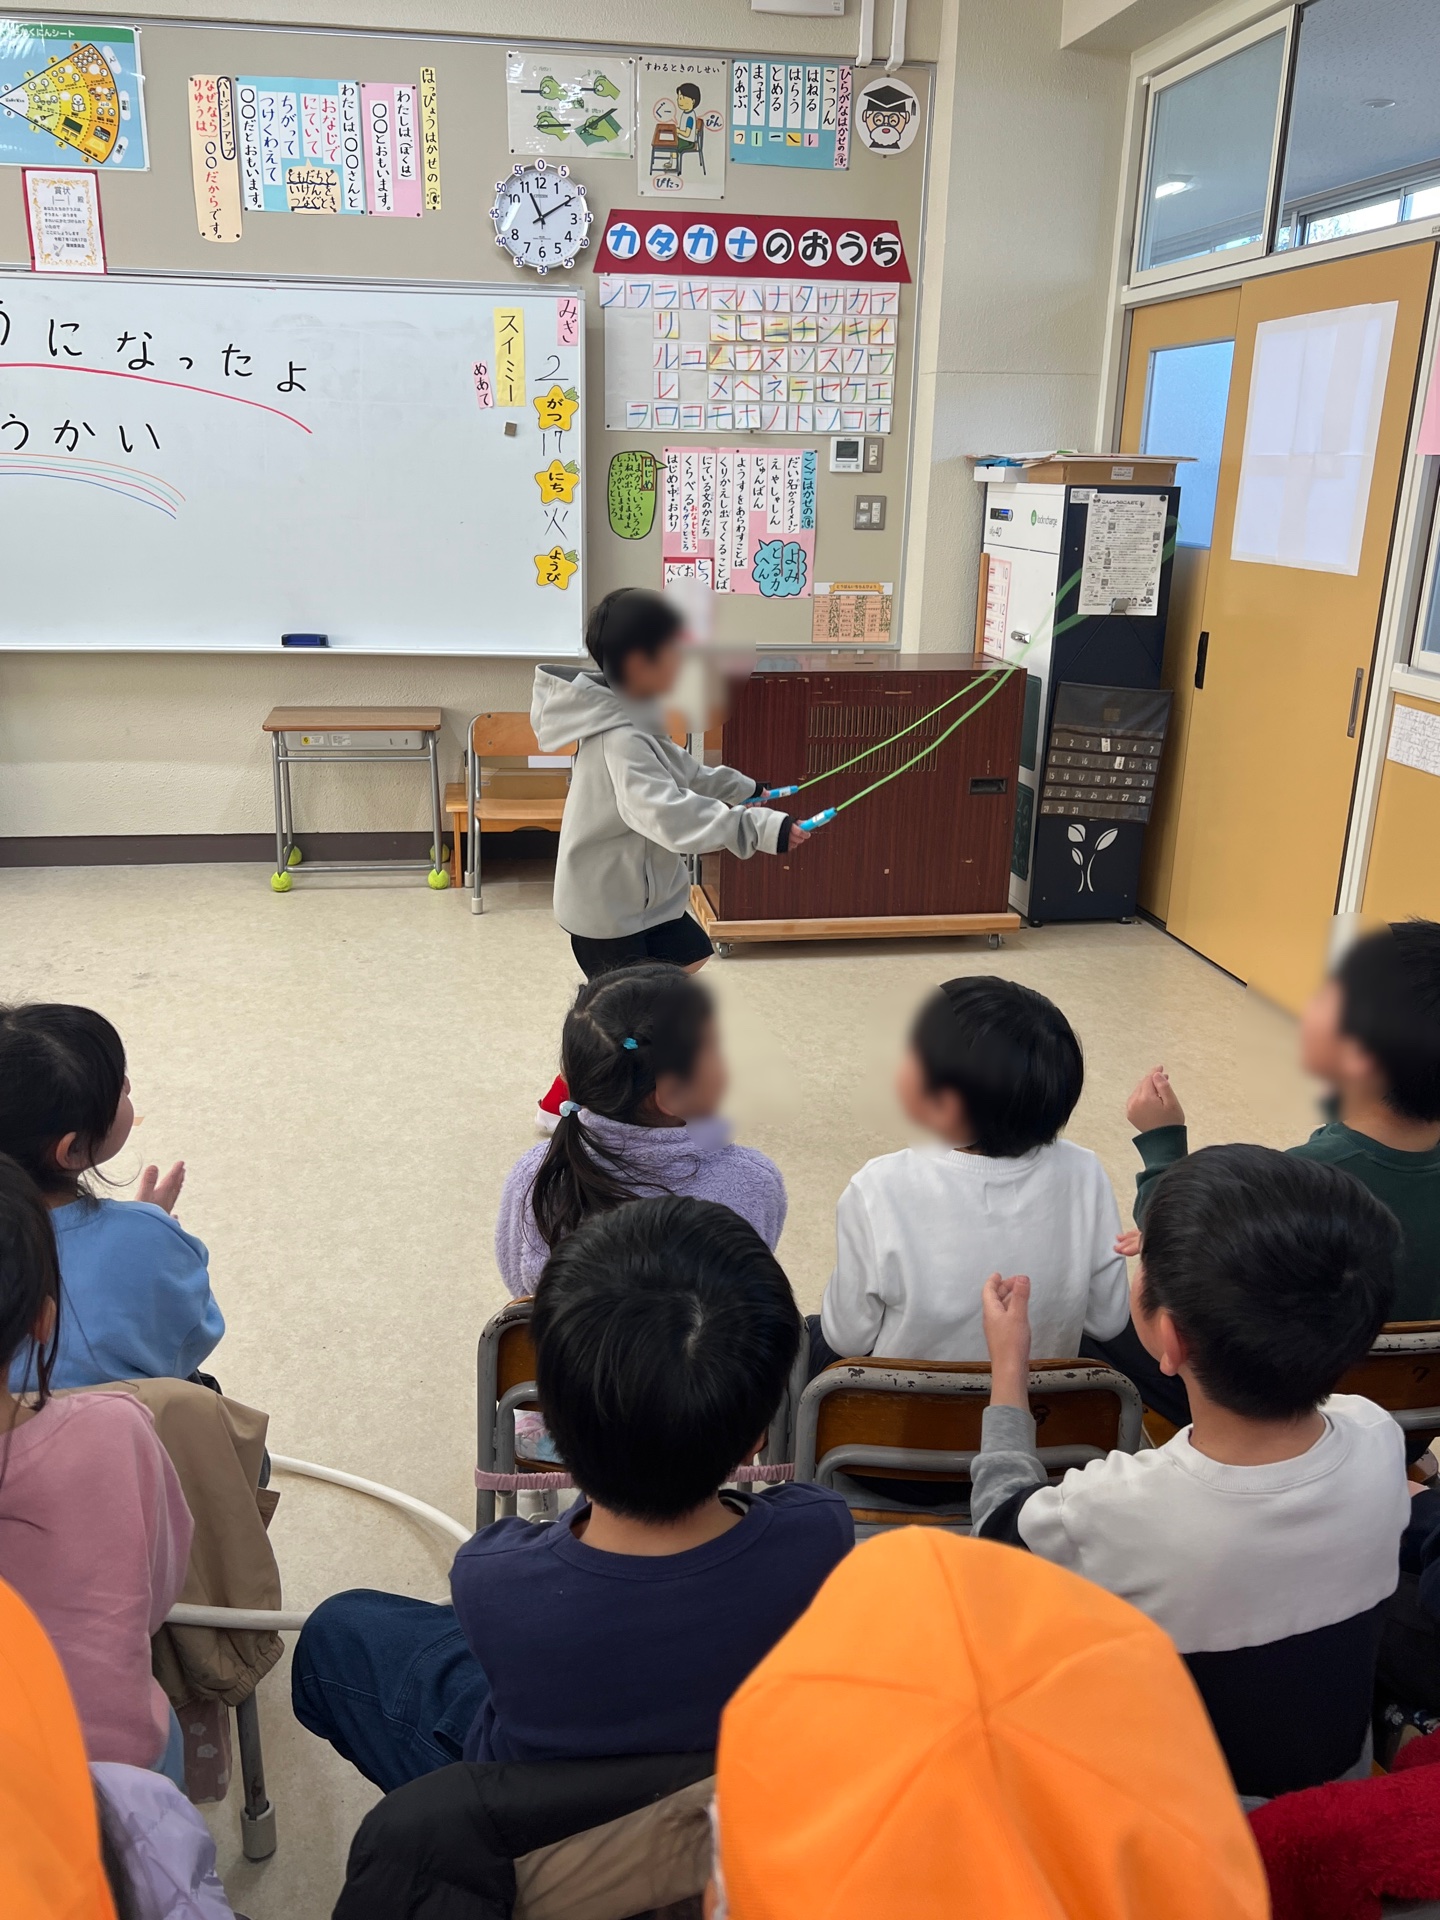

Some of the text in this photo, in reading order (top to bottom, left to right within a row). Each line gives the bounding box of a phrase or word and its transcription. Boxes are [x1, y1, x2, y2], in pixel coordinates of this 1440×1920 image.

[644, 62, 720, 74] すわるときのしせい
[752, 64, 765, 117] まっすぐ
[770, 66, 784, 112] とめる
[788, 68, 802, 114] はらう
[806, 69, 820, 112] はねる
[193, 79, 208, 131] りゆうは
[822, 69, 837, 126] こっつん
[205, 79, 218, 133] なぜなら
[655, 102, 672, 118] ぐー
[281, 94, 297, 156] ちがって
[303, 96, 320, 155] にていて
[706, 114, 722, 127] ぴん
[321, 97, 340, 163] おなじで
[259, 96, 279, 183] つけくわえて
[514, 165, 523, 175] 55
[537, 159, 545, 170] 0
[560, 165, 567, 176] 5
[288, 169, 335, 184] ともだちと
[534, 176, 547, 190] 12
[54, 186, 71, 195] 賞状
[496, 182, 507, 192] 50
[520, 181, 530, 194] 11
[554, 182, 559, 194] 1
[577, 186, 586, 196] 10
[290, 196, 336, 211] つなぐとき
[489, 208, 500, 218] 45
[570, 213, 578, 225] 3
[584, 213, 593, 223] 15
[496, 236, 507, 246] 40
[511, 229, 519, 241] 8
[564, 231, 572, 243] 4
[523, 241, 531, 254] 7
[554, 242, 562, 254] 5
[580, 239, 589, 247] 20
[609, 224, 900, 266] カタカナのおうち
[538, 246, 546, 259] 6
[515, 256, 524, 266] 35
[564, 257, 573, 267] 25
[539, 265, 549, 274] 30
[499, 315, 519, 402] スイミー
[535, 355, 569, 381] 2
[473, 363, 489, 406] めあて
[546, 398, 564, 422] がつ
[542, 431, 563, 456] 17
[644, 458, 653, 490] はじめ
[684, 455, 696, 506] くらべる
[549, 472, 564, 493] にち
[753, 456, 767, 510] じゅんばん
[735, 457, 747, 568] ようすをあらわすことば
[544, 508, 569, 541] 火
[546, 550, 561, 583] ようび
[758, 557, 770, 579] へん
[785, 552, 799, 583] よみ
[1069, 739, 1074, 747] 2
